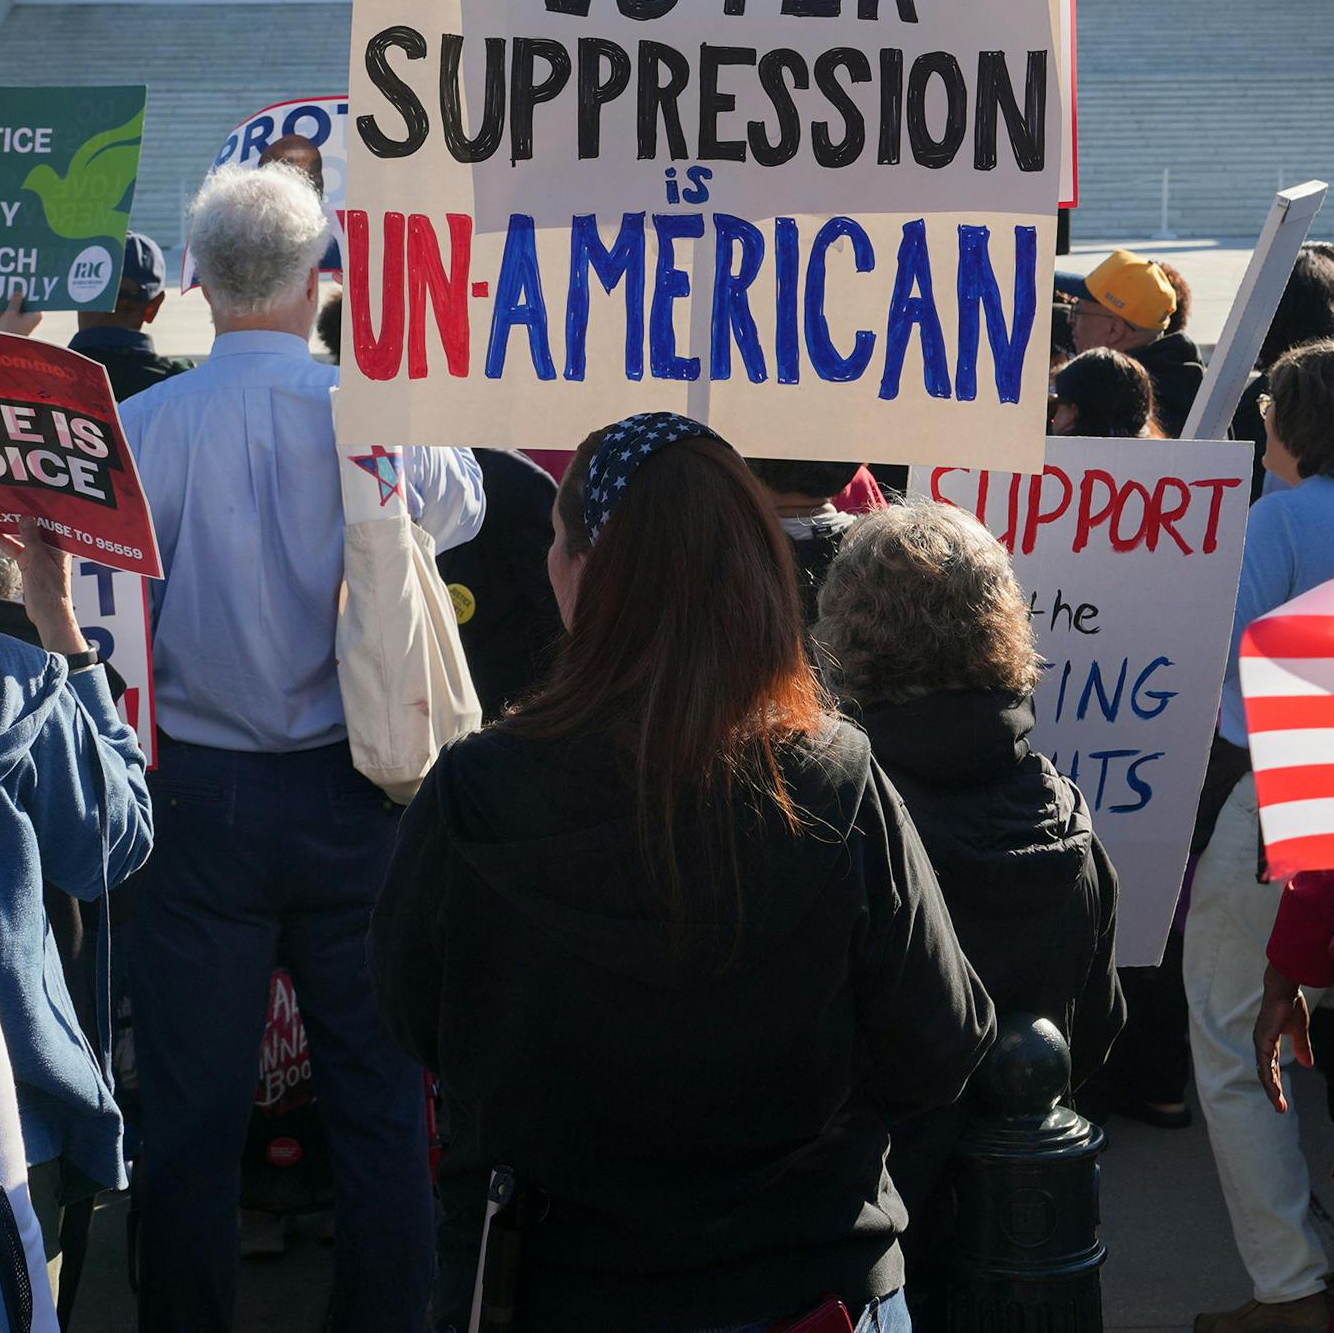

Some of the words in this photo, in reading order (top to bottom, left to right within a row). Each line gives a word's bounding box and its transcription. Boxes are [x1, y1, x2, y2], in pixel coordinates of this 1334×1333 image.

[357, 24, 1049, 173] SUPPRESSION
[213, 104, 349, 168] PRO
[665, 165, 713, 205] is
[345, 210, 1037, 404] UN-AMERICAN
[52, 410, 110, 460] IS
[36, 518, 72, 540] AUSE
[75, 531, 93, 546] TO
[95, 538, 144, 560] 95559
[1028, 589, 1102, 635] the
[1040, 656, 1180, 723] ING
